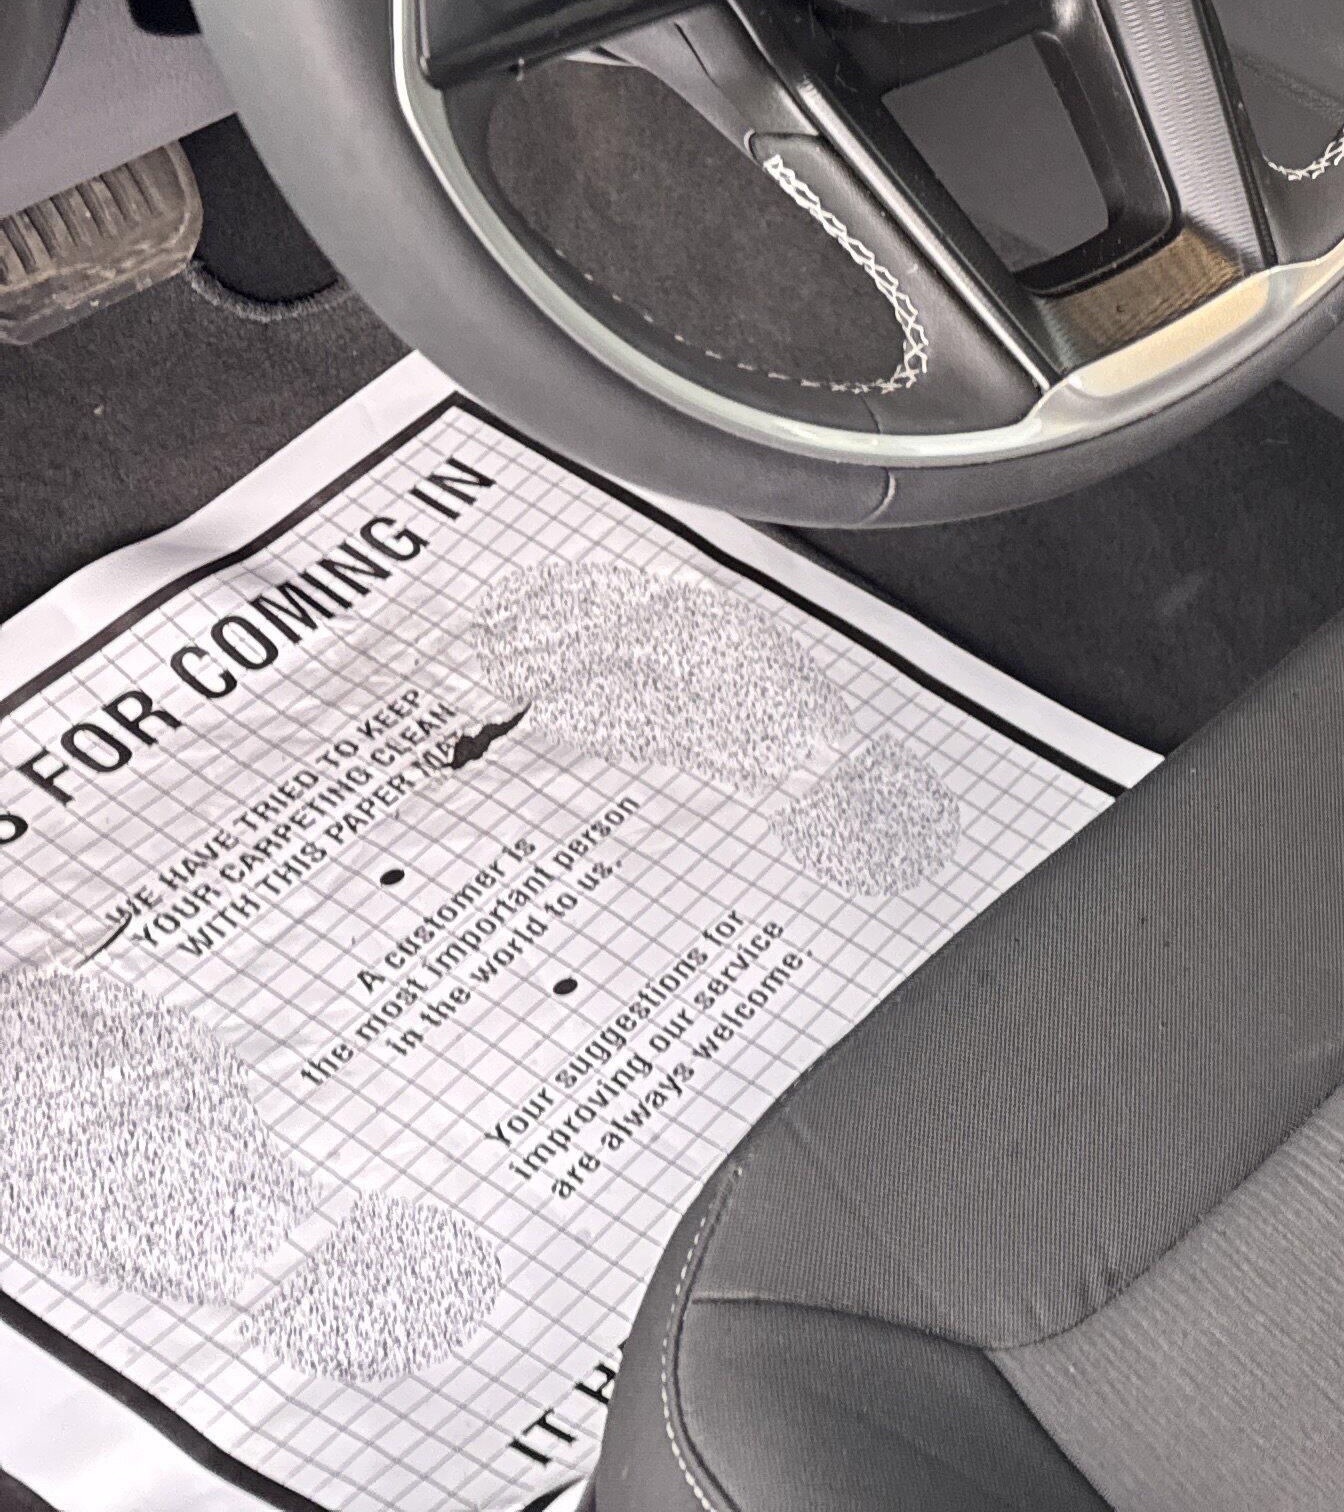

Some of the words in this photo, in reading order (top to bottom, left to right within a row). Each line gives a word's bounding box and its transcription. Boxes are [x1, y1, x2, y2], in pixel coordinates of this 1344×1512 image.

[16, 689, 183, 807] FOR
[170, 515, 430, 700] COMING
[410, 456, 497, 521] IN
[105, 885, 163, 926] WE
[159, 828, 239, 890] HAVE
[233, 769, 319, 832] TRIED
[315, 738, 360, 769] TO
[356, 688, 420, 740] KEEP
[132, 882, 221, 947] YOUR
[219, 765, 373, 884] CARPETING
[370, 702, 458, 768] CLEAN
[178, 893, 260, 957] WITH
[253, 841, 328, 896] THIS
[323, 773, 416, 845] PAPER
[356, 967, 387, 996] A
[384, 857, 508, 970] customer
[501, 837, 536, 863] is
[301, 1041, 354, 1088] the
[355, 976, 429, 1042] most
[421, 863, 558, 979] important
[552, 794, 641, 873] person
[386, 1025, 425, 1057] in
[420, 987, 471, 1029] the
[469, 913, 550, 985] world
[544, 891, 579, 919] to
[484, 1086, 556, 1149] Your
[553, 945, 708, 1090] suggestions
[701, 908, 748, 948] for
[508, 1051, 654, 1182] improving
[648, 1006, 697, 1054] our
[693, 920, 784, 1011] service
[551, 1150, 602, 1202] are
[599, 1060, 695, 1152] always
[508, 1408, 577, 1467] IT
